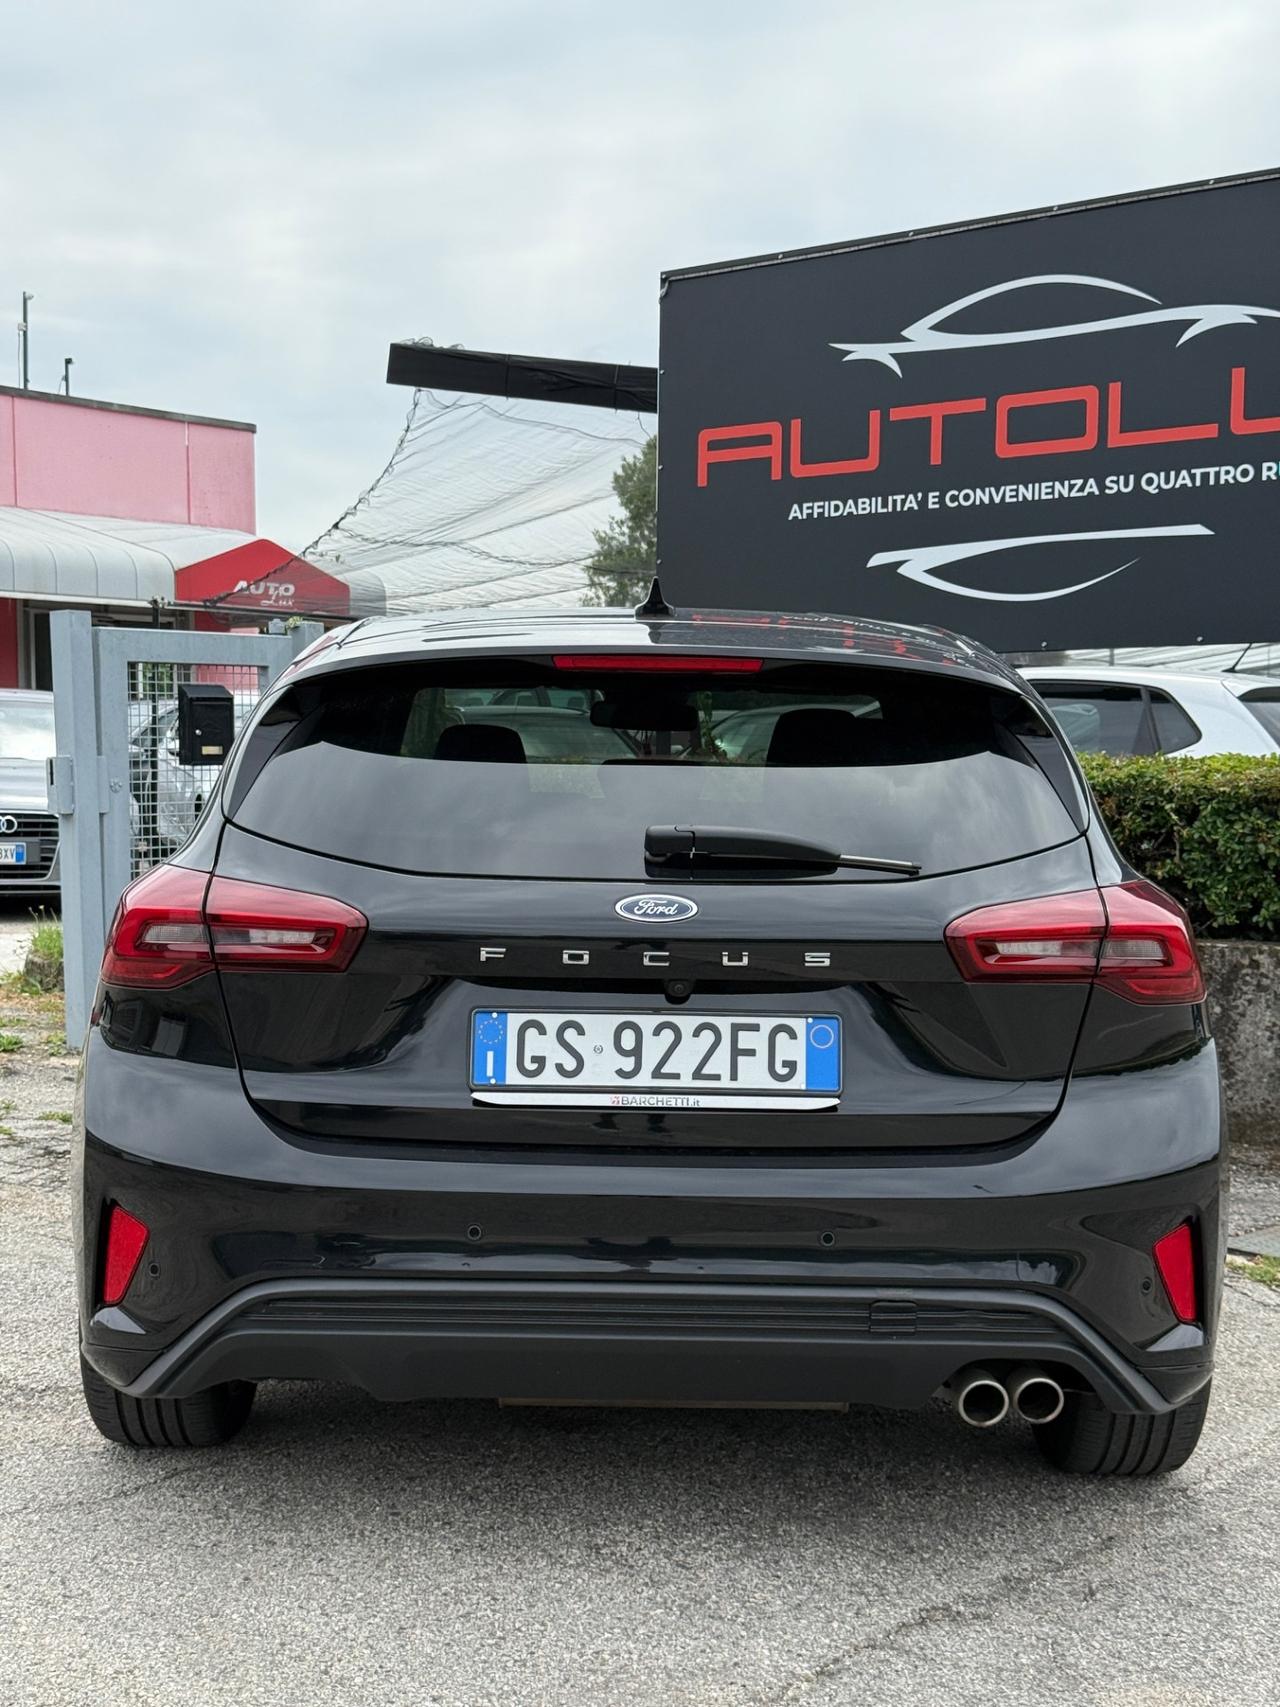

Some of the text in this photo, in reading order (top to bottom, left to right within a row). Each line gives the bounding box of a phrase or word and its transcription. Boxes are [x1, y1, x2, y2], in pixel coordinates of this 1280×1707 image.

[928, 491, 939, 509] E
[945, 478, 1099, 508] CONVENIENZA
[1105, 474, 1134, 494] SU
[1141, 464, 1254, 494] QUATTRO
[1261, 461, 1280, 481] R
[233, 580, 295, 596] AUTO
[634, 899, 679, 915] Ford
[479, 947, 831, 967] FOCUS
[516, 1019, 586, 1079] GS
[613, 1020, 798, 1083] 922FG
[621, 1096, 701, 1107] BARCHETTI.it
